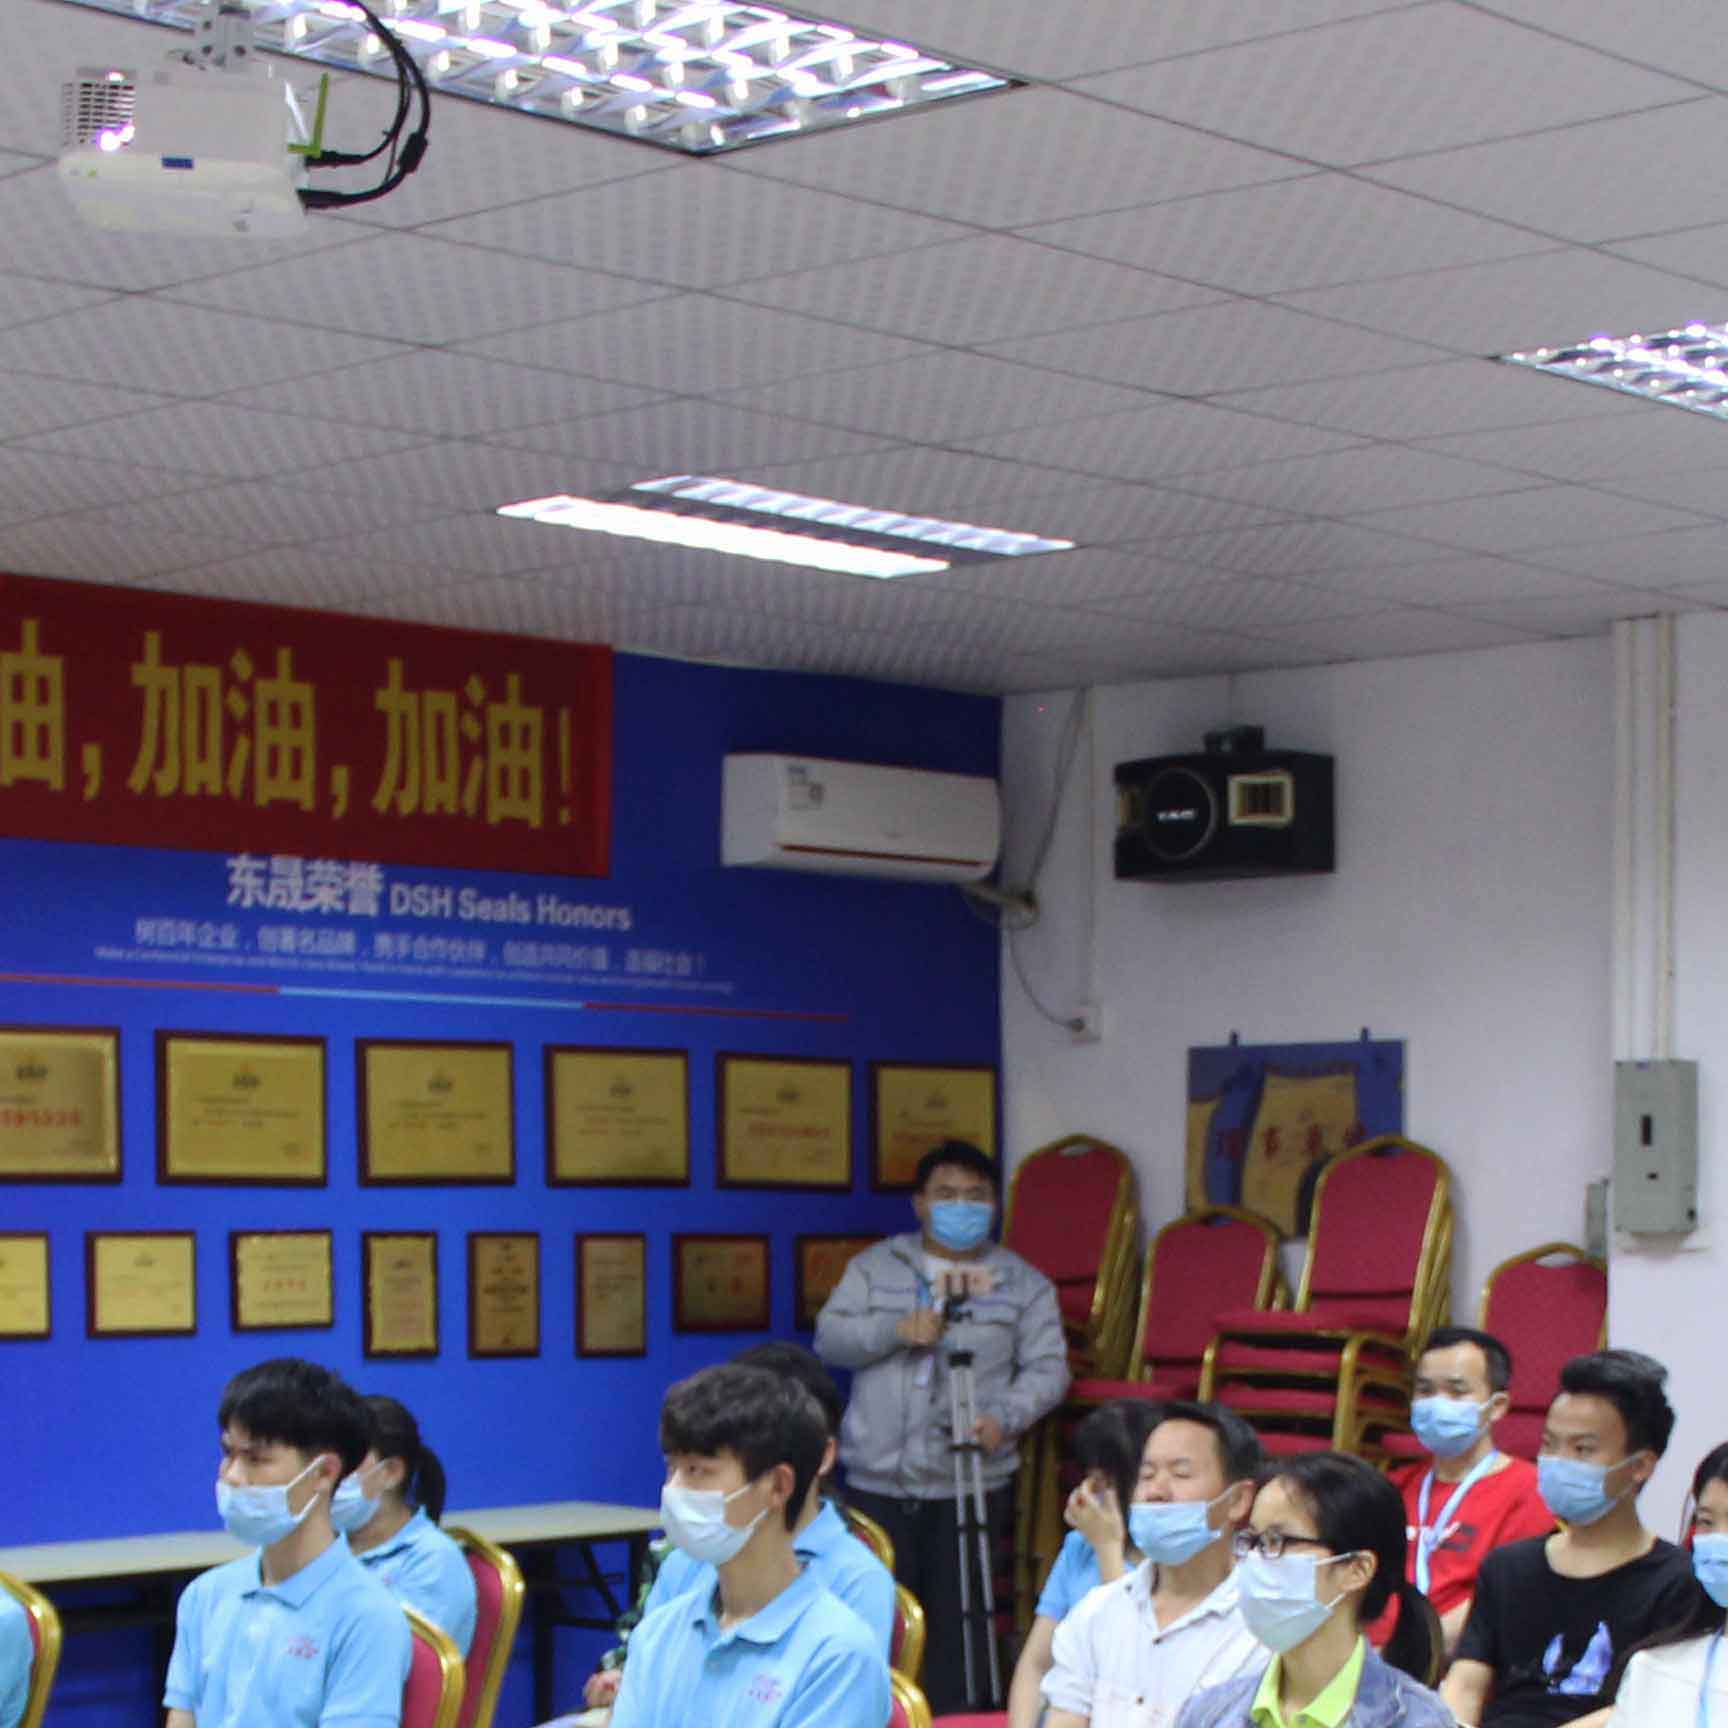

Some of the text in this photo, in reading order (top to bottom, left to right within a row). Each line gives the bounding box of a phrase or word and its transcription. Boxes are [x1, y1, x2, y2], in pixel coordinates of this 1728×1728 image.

[226, 853, 633, 931] 东晟荣誉 DSH Seals Honors
